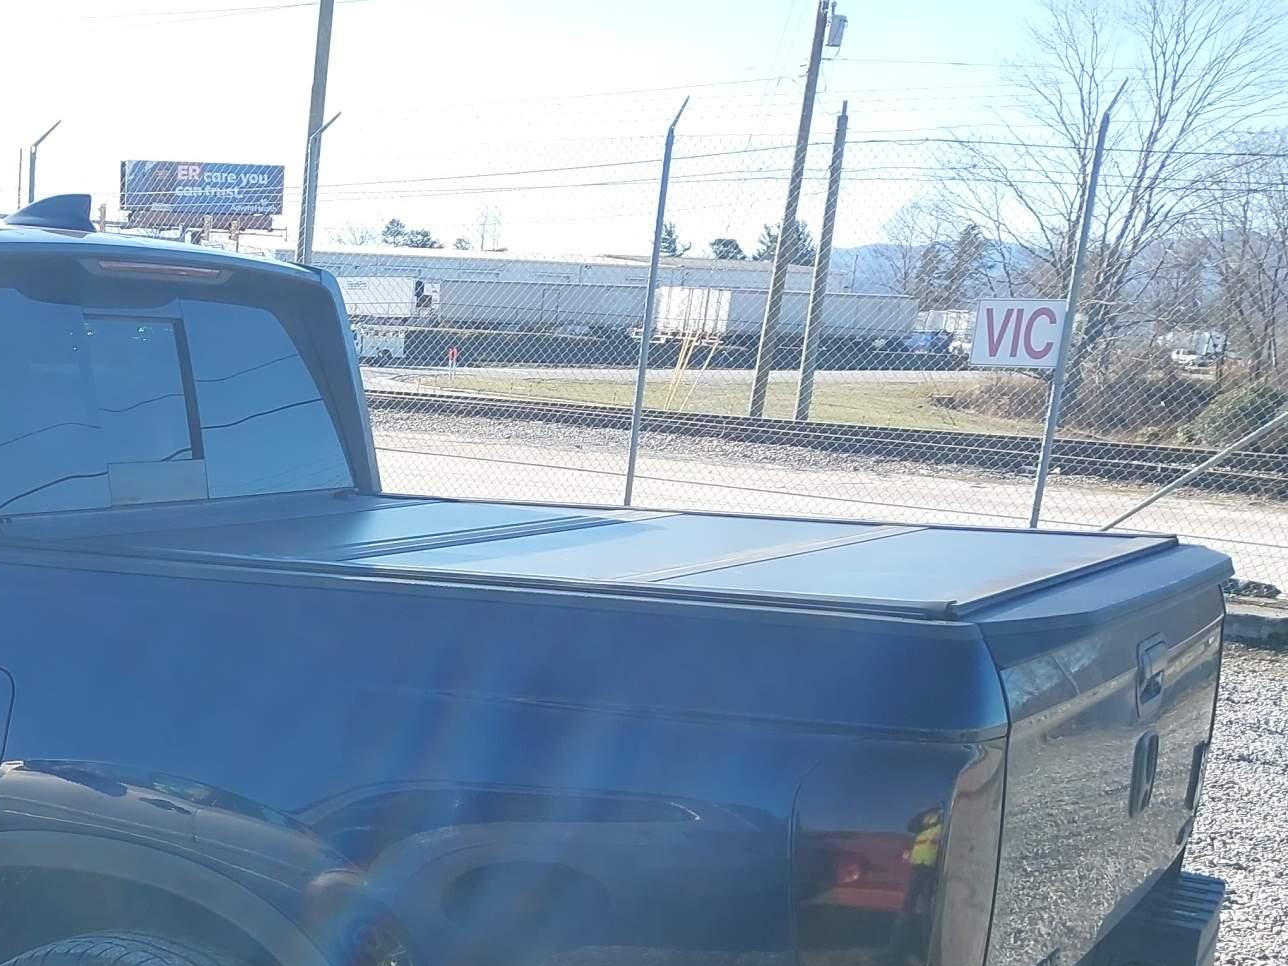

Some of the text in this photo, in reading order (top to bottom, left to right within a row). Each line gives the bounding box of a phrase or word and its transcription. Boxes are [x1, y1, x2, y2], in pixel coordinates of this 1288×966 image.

[177, 165, 268, 186] ER care you
[175, 186, 202, 197] can
[986, 307, 1057, 360] VIC
